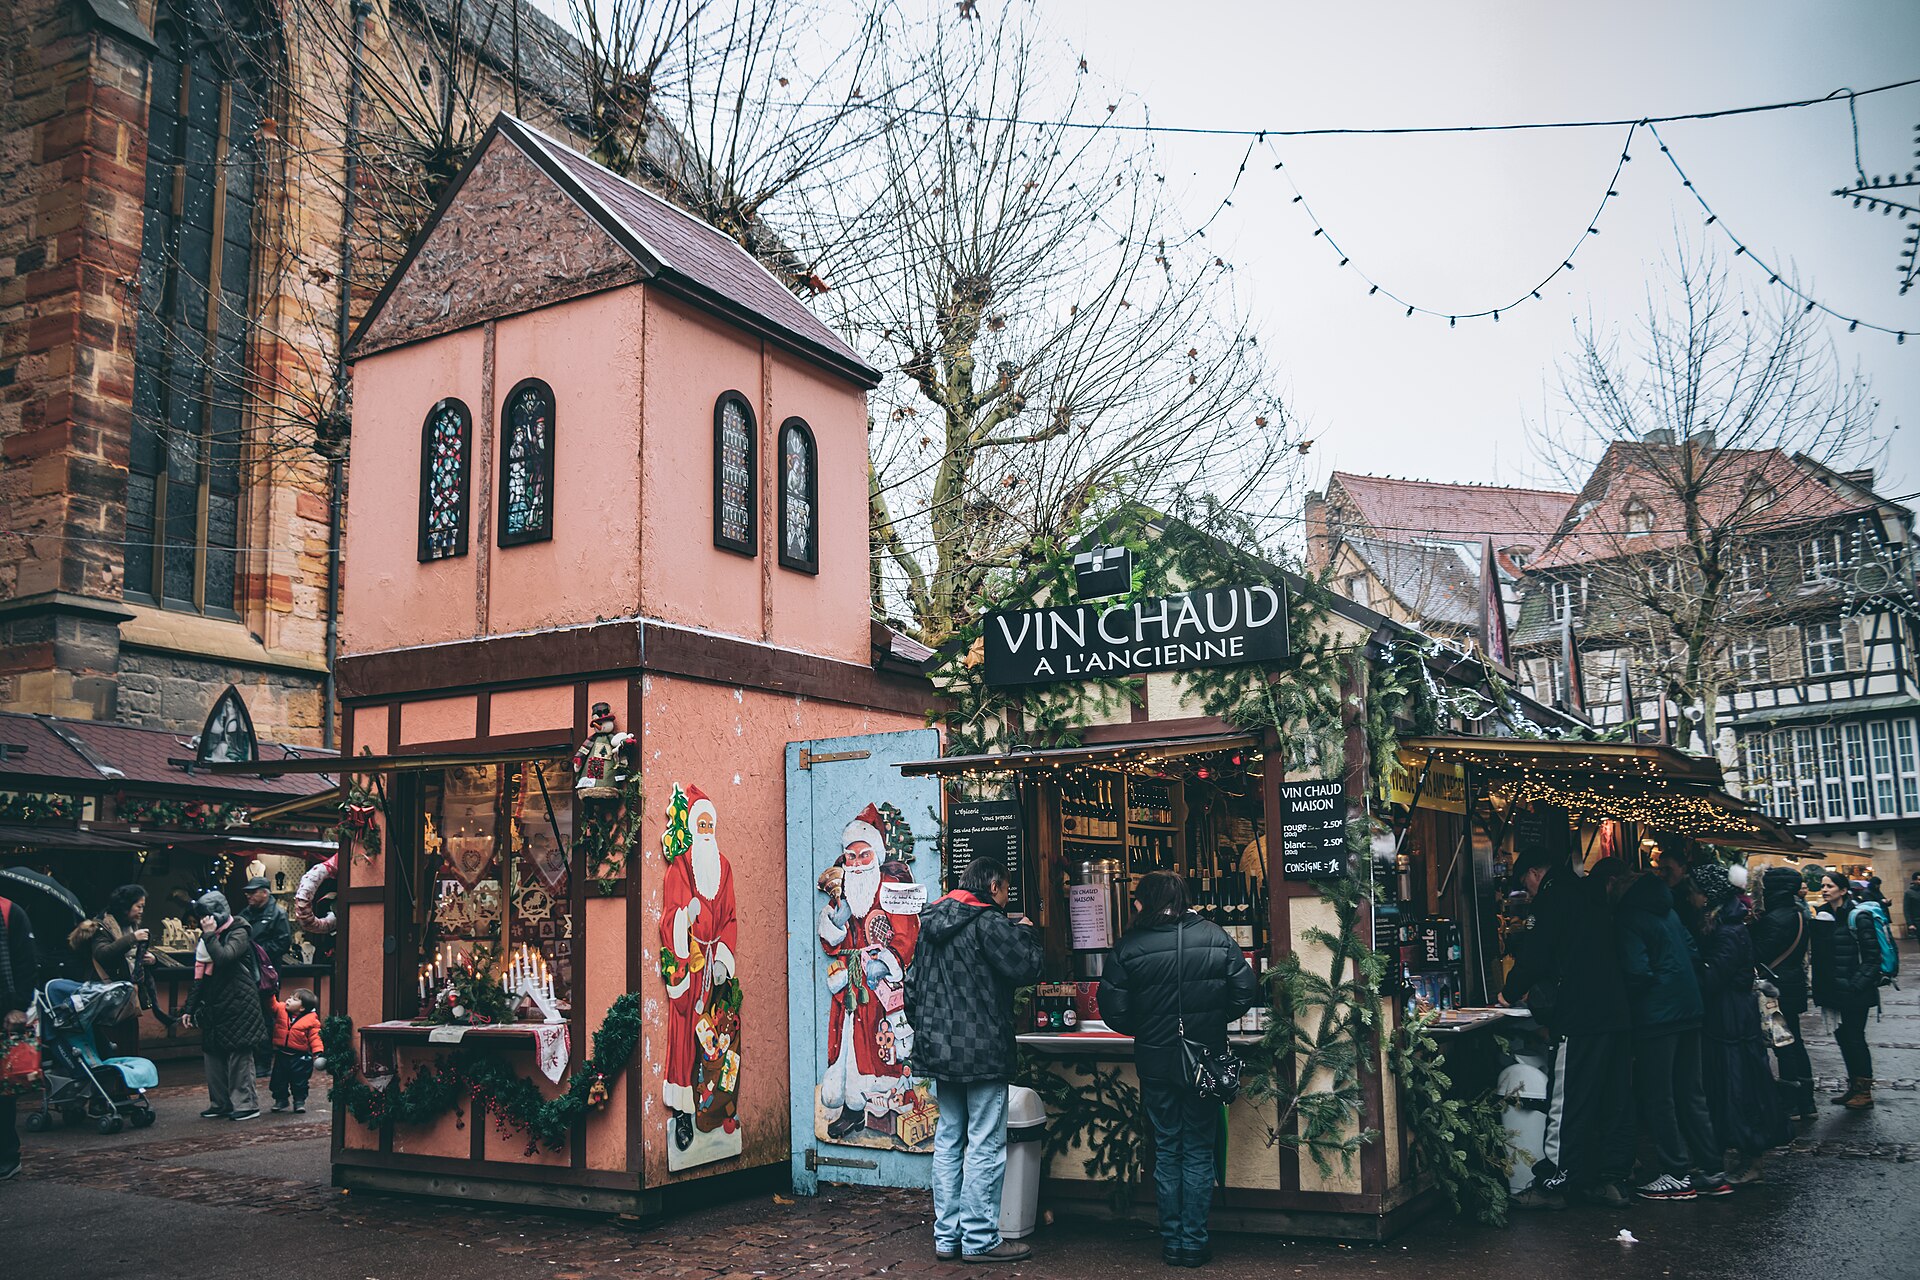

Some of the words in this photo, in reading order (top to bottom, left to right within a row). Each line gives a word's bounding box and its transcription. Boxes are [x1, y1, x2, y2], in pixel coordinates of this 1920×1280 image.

[996, 608, 1085, 654] VIN
[1097, 585, 1279, 645] CHAUD
[1033, 657, 1054, 676] A
[1065, 636, 1244, 674] L'ANCIENNE
[1281, 787, 1302, 799] VIN
[1304, 783, 1342, 797] CHAUD
[1292, 799, 1334, 812] MAISON
[1283, 823, 1307, 833] rouge
[1284, 840, 1307, 849] blanc
[1422, 928, 1439, 962] perle
[1042, 986, 1060, 996] perle
